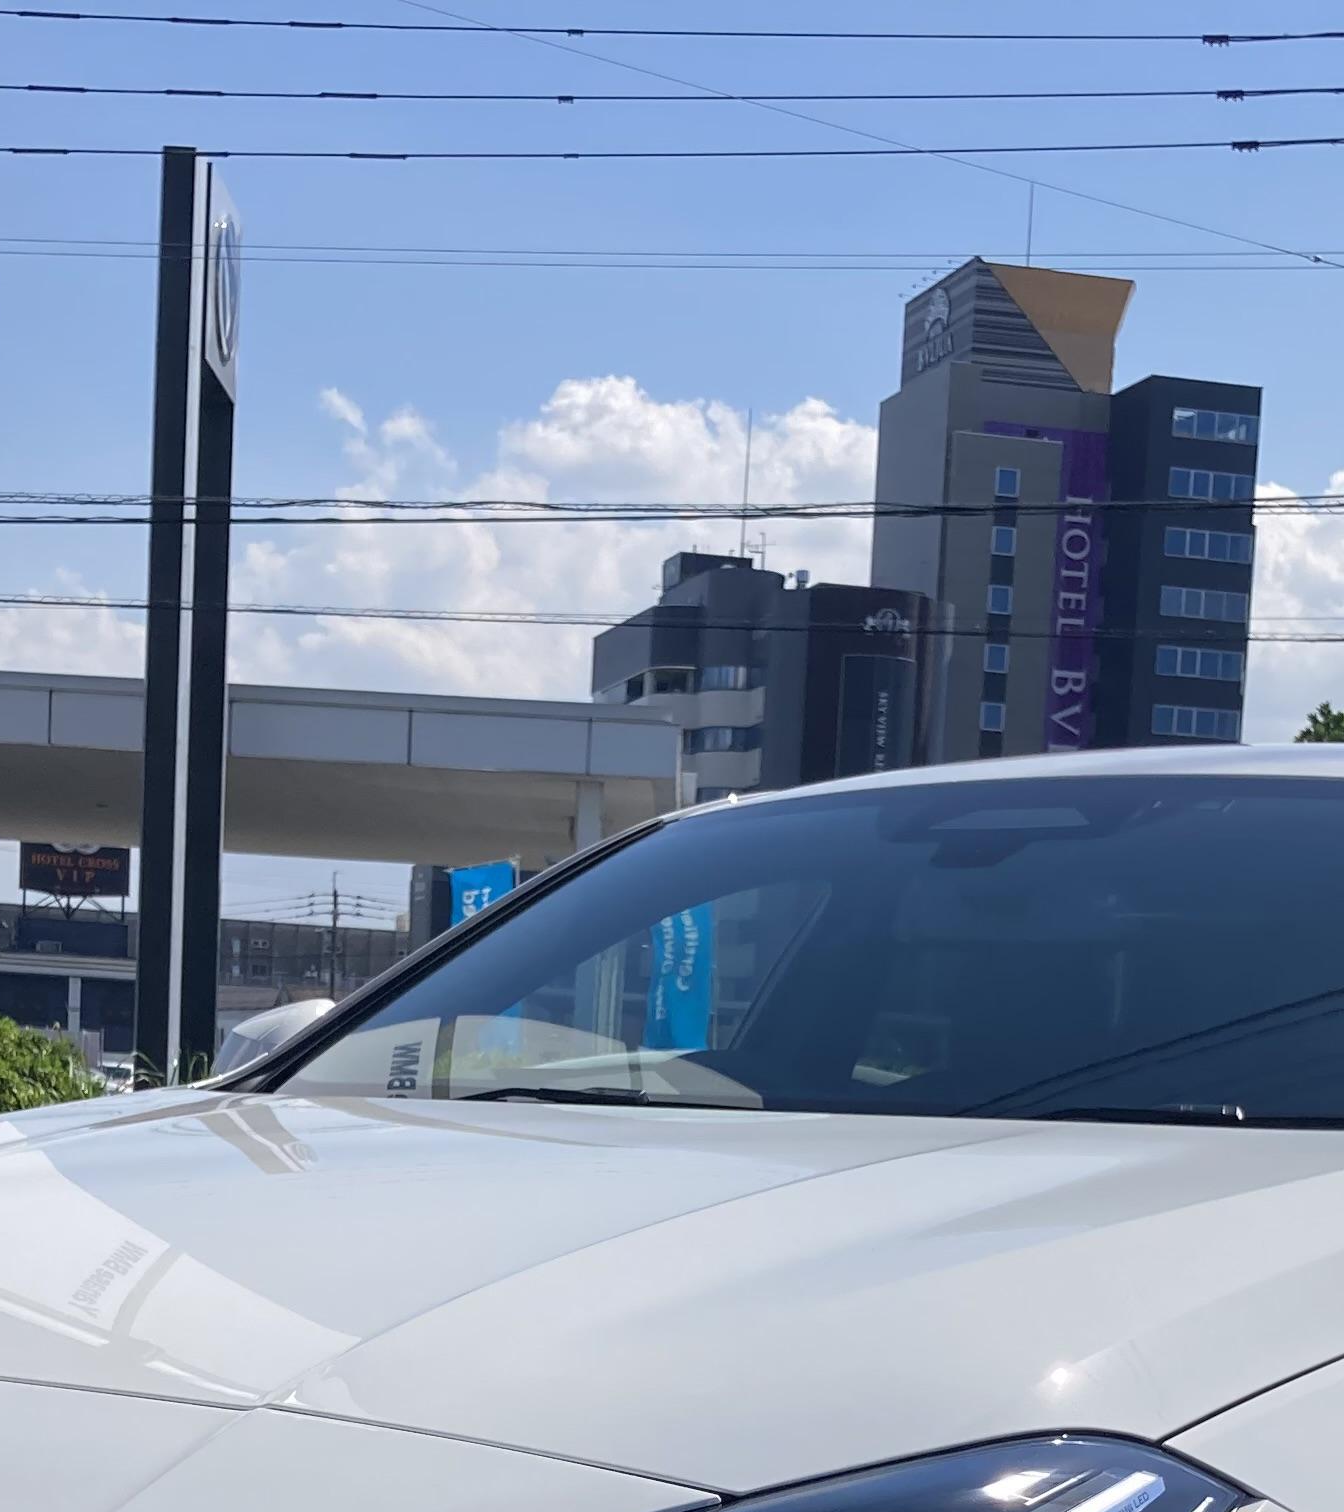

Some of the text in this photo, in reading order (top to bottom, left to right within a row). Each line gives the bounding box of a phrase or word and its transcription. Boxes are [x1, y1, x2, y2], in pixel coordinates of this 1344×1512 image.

[1048, 495, 1093, 751] HOTEL BV
[1132, 1491, 1149, 1508] LED
